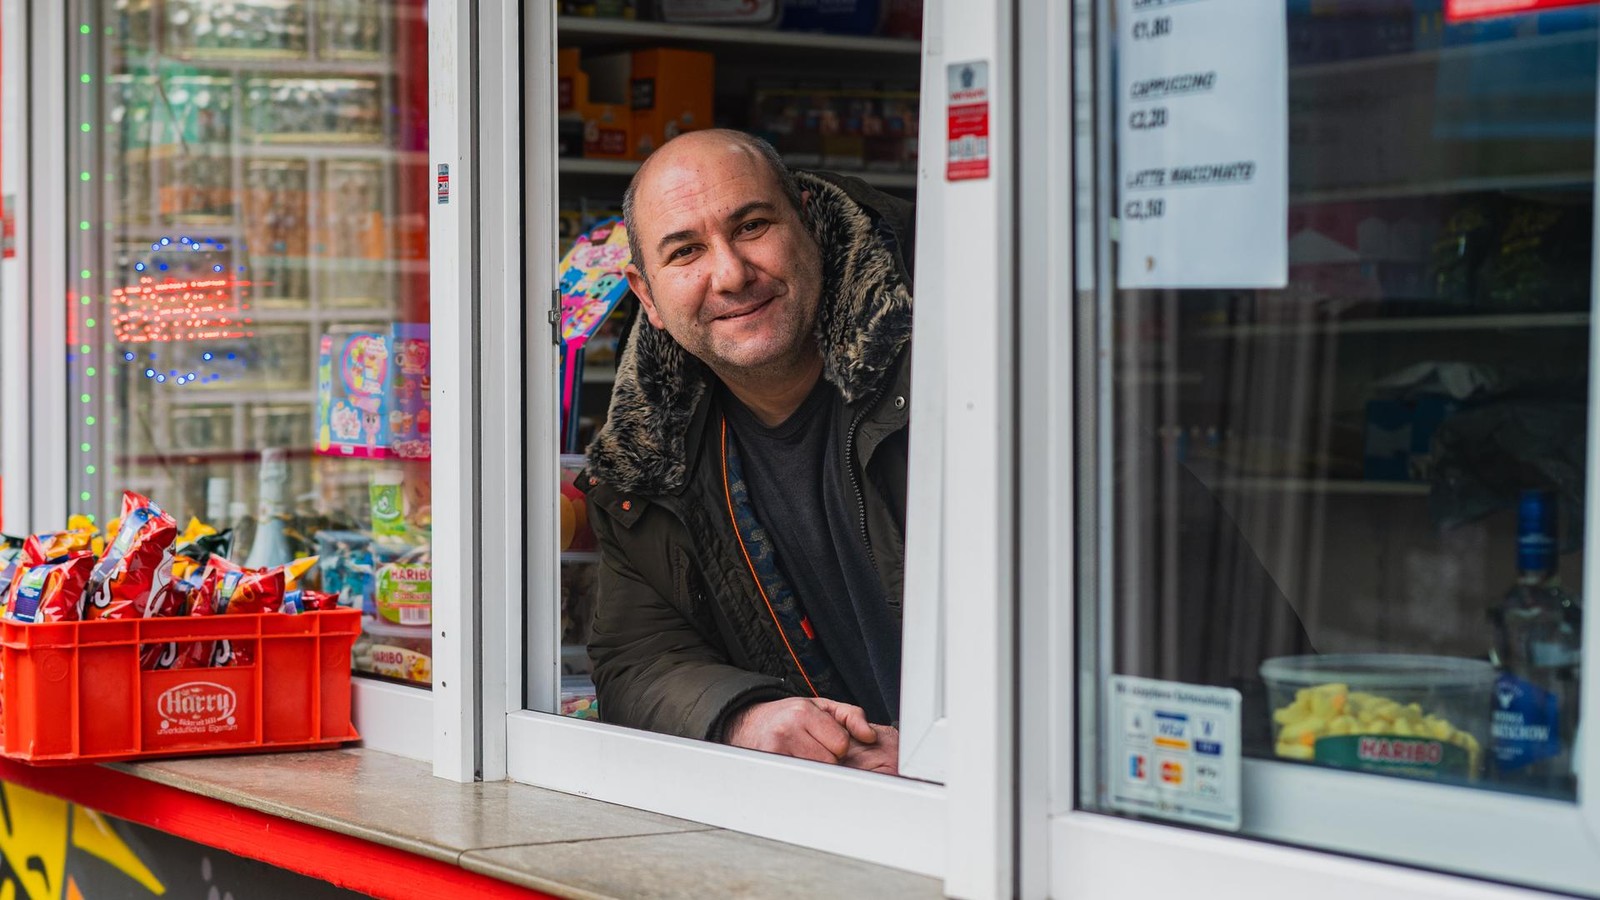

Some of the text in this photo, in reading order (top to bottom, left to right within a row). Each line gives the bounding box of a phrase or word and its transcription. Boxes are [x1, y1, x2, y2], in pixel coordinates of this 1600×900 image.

[1131, 71, 1216, 97] CAPPUCCINO
[1127, 167, 1166, 188] LATTE
[166, 690, 229, 717] Harry
[1359, 736, 1442, 763] HARIBO
